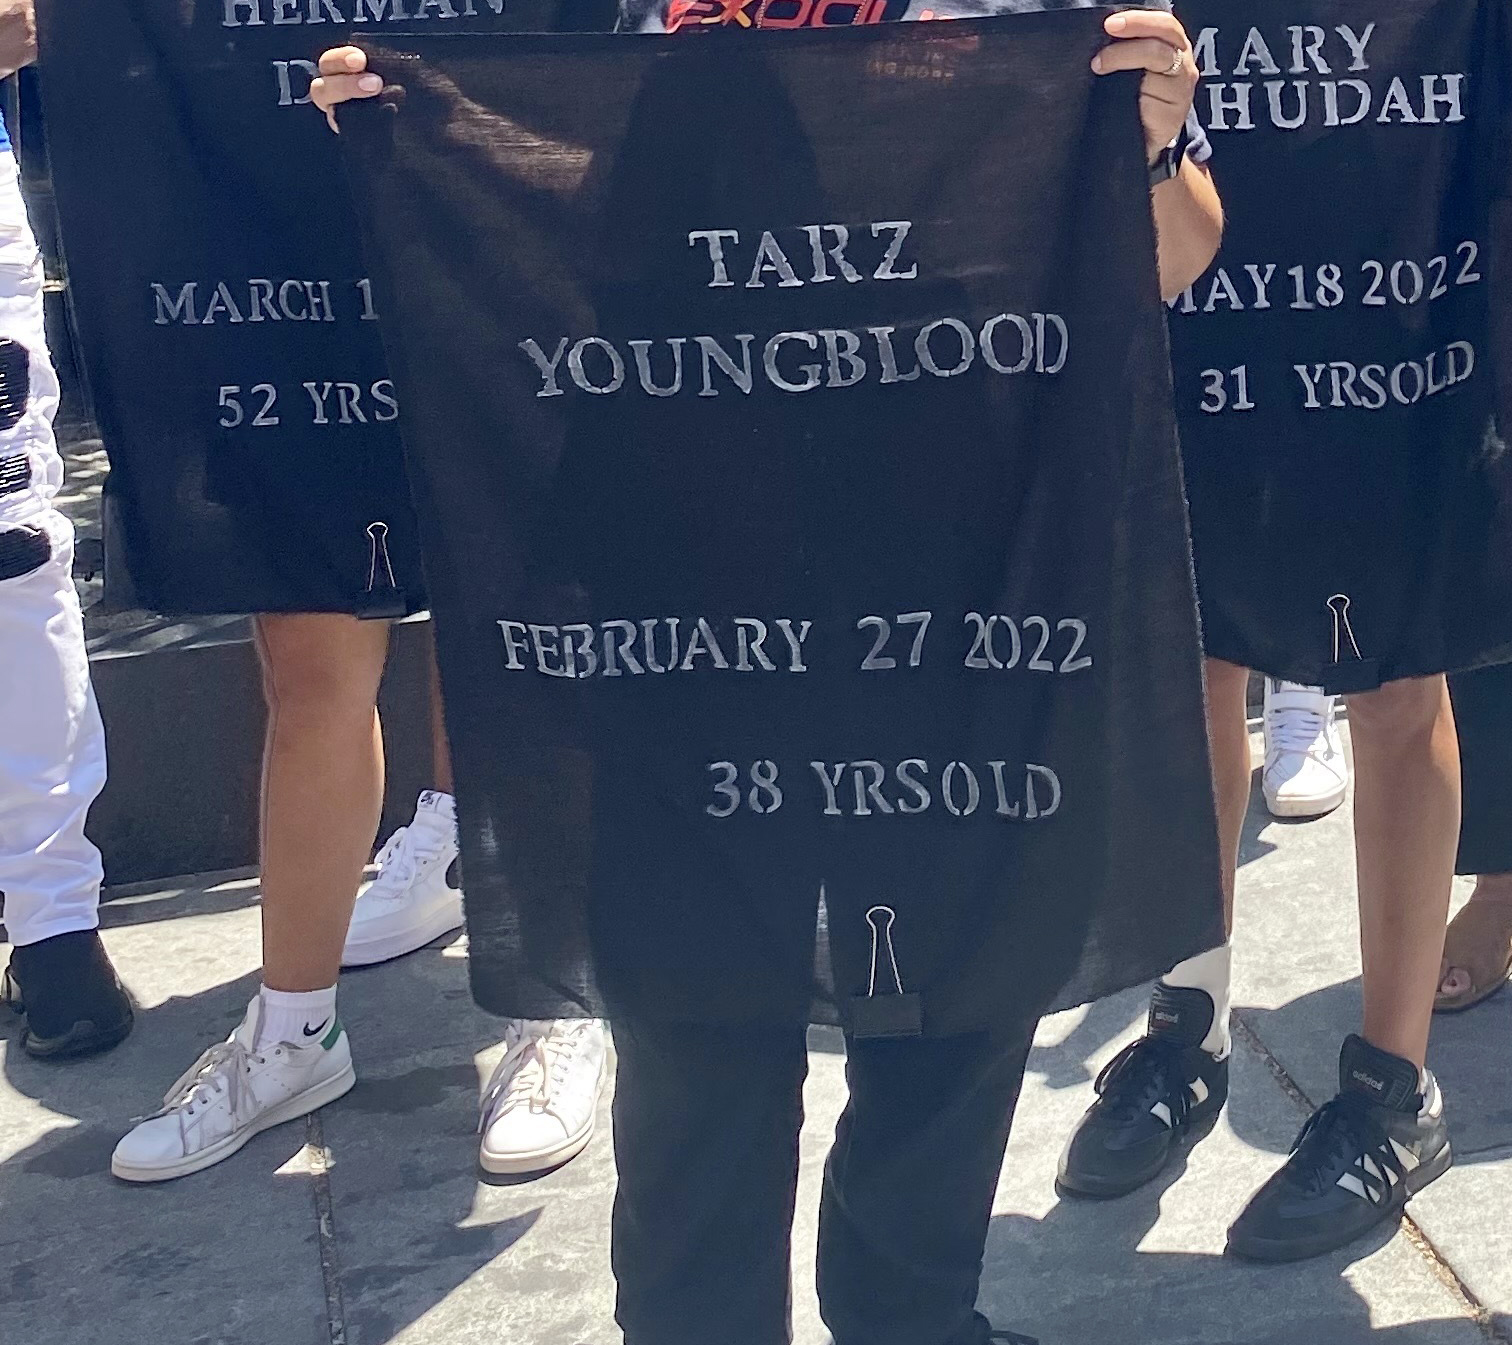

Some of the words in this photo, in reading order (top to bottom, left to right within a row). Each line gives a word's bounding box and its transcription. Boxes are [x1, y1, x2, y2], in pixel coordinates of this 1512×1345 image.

[688, 220, 918, 289] TARZ
[1361, 240, 1480, 306] 2022
[150, 279, 335, 325] MARCH
[517, 313, 1070, 397] YOUNGBLOOD
[218, 383, 279, 427] 52
[302, 379, 399, 423] YRS
[1200, 364, 1255, 413] 31
[497, 617, 812, 679] FEBRUARY
[856, 611, 932, 671] 27
[963, 611, 1093, 673] 2022
[706, 759, 784, 817] 38
